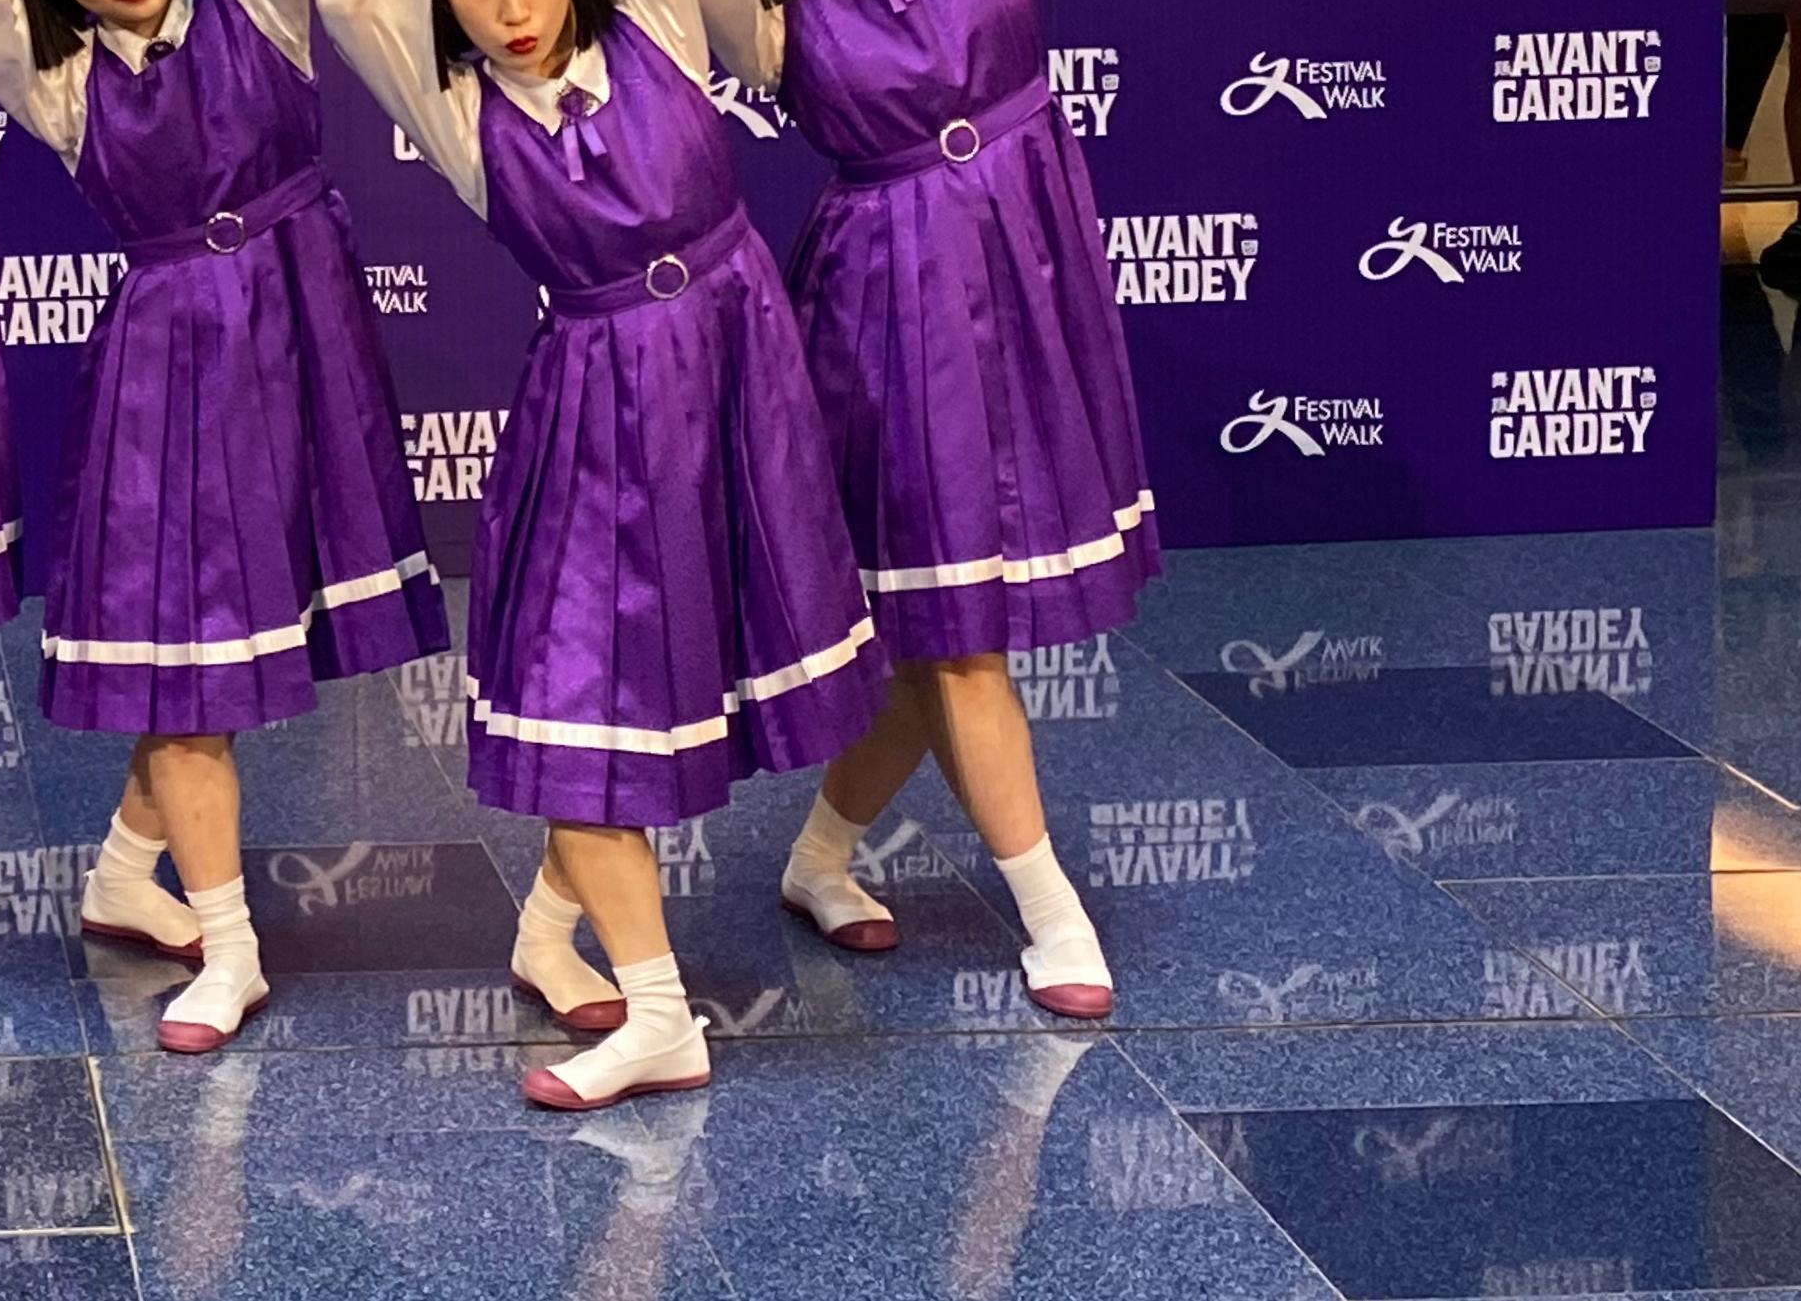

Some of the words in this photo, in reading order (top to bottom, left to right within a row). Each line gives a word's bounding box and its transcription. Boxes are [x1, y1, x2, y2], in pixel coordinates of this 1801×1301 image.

[1297, 58, 1385, 84] FESTIVAL
[1512, 29, 1646, 77] AVANT
[1322, 85, 1385, 110] WALK
[1494, 74, 1658, 123] GARDEY
[1107, 212, 1242, 260] AVANT
[1434, 223, 1521, 249] FESTIVAL
[1459, 249, 1521, 274] WALK
[1114, 258, 1255, 304] ARDEY
[1508, 365, 1641, 413] AVANT
[1295, 396, 1382, 422] FESTIVAL
[1320, 423, 1382, 447] WALK
[1490, 409, 1653, 459] GARDEY
